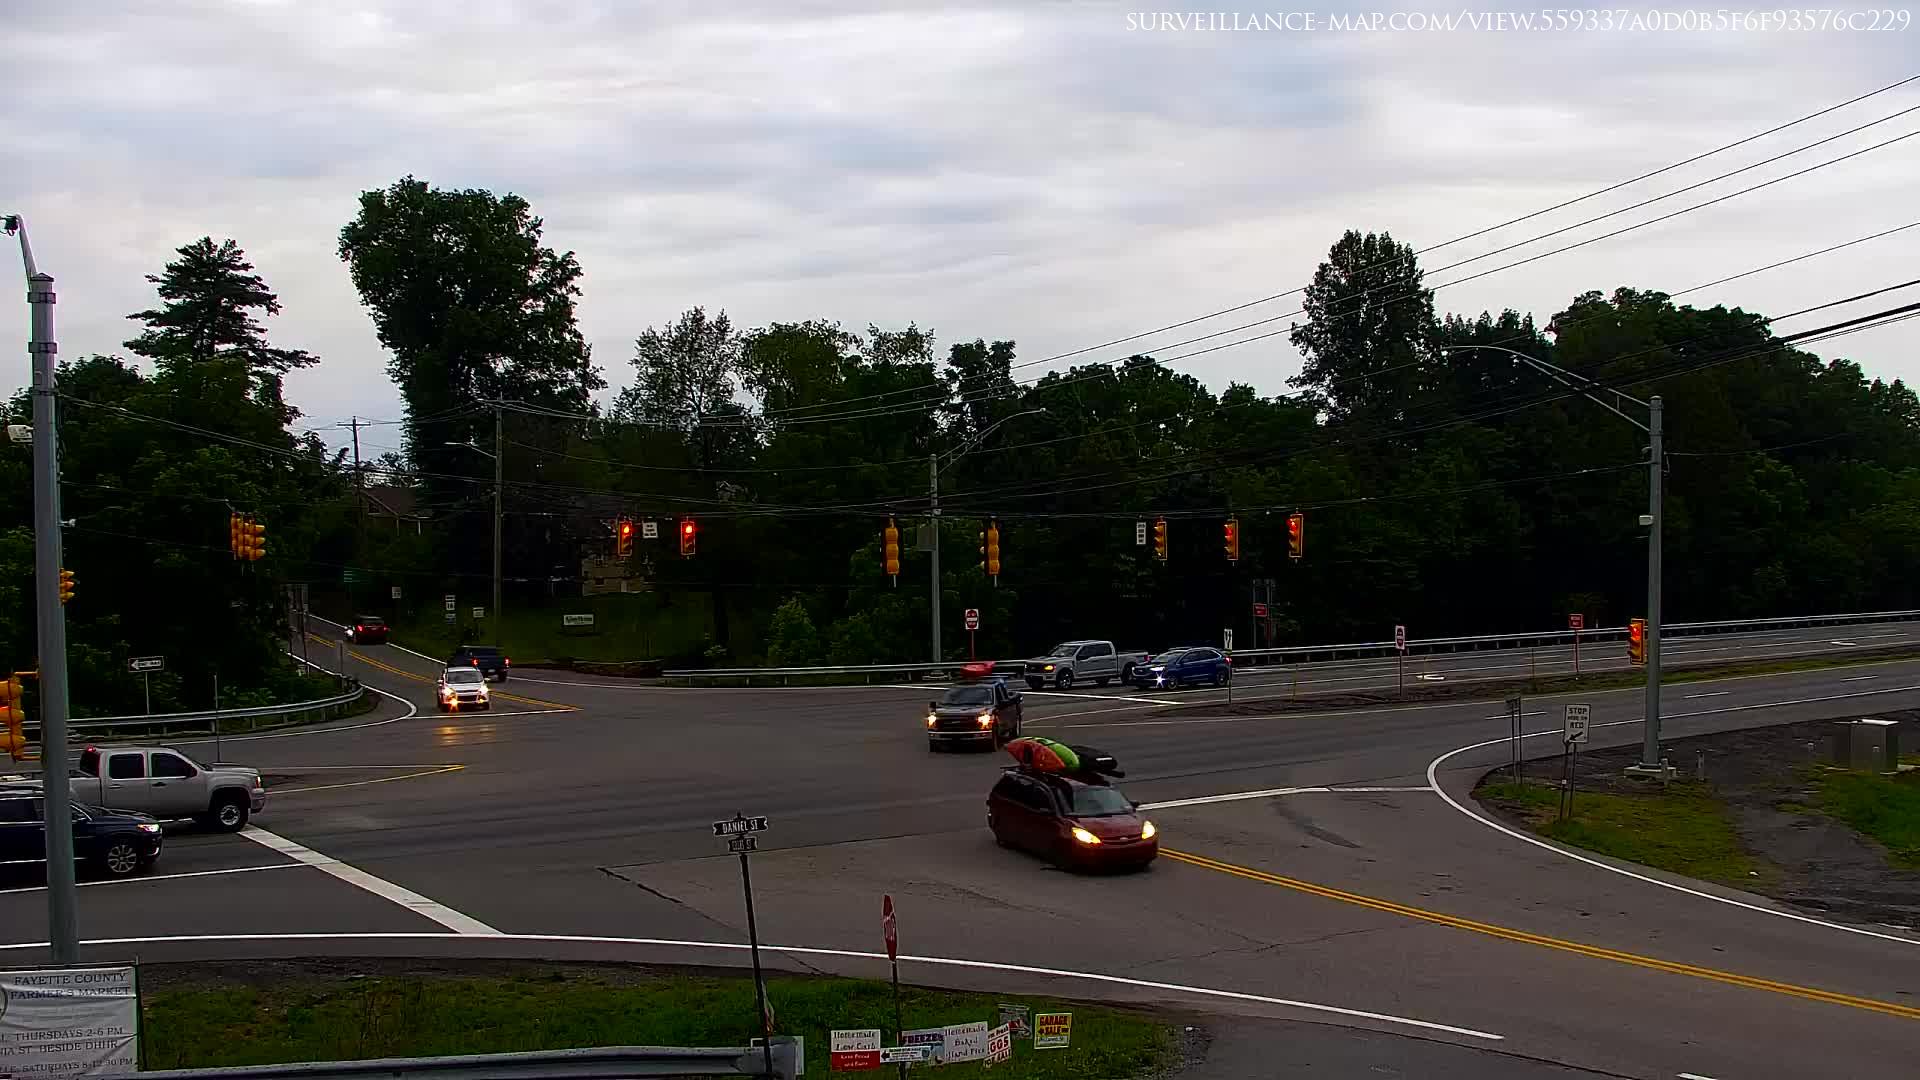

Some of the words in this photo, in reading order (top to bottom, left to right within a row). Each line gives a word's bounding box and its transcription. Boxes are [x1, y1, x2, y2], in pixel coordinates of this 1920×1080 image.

[722, 820, 749, 834] DANIEL
[750, 819, 758, 830] ST
[14, 975, 71, 985] FAYETTE
[74, 972, 127, 984] COUNTY
[79, 986, 131, 996] MARKET
[1039, 1015, 1068, 1025] GARAGE
[15, 1029, 83, 1041] THURSDAYS
[86, 1028, 104, 1037] 2-6
[107, 1027, 123, 1036] PM
[39, 1042, 82, 1053] BESIDE
[22, 1063, 80, 1074] SATURDAYS
